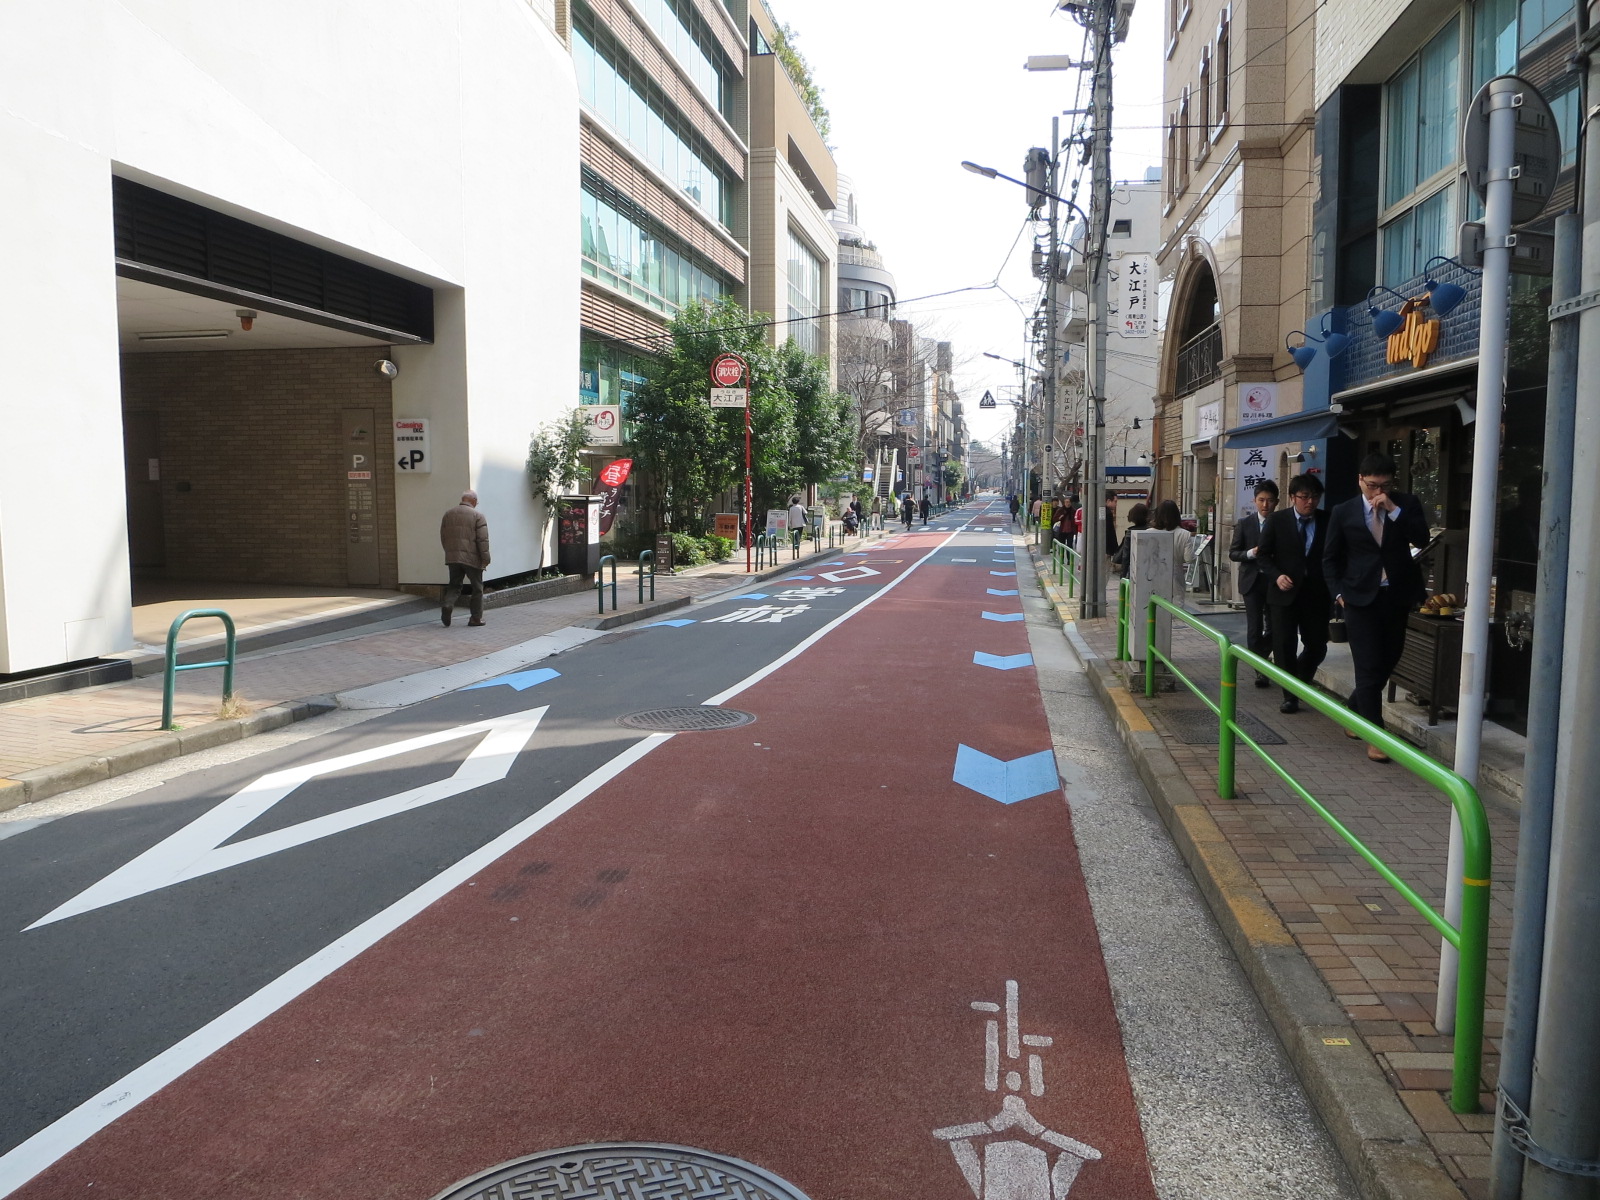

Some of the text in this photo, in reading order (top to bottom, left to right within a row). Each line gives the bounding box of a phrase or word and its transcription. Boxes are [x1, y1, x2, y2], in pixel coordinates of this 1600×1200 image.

[1129, 261, 1141, 310] 大江戸
[719, 367, 739, 376] 消火栓
[713, 394, 744, 402] 大江戸
[353, 455, 364, 468] P
[410, 450, 424, 469] P
[605, 465, 620, 484] 昼
[600, 488, 617, 518] ランチ
